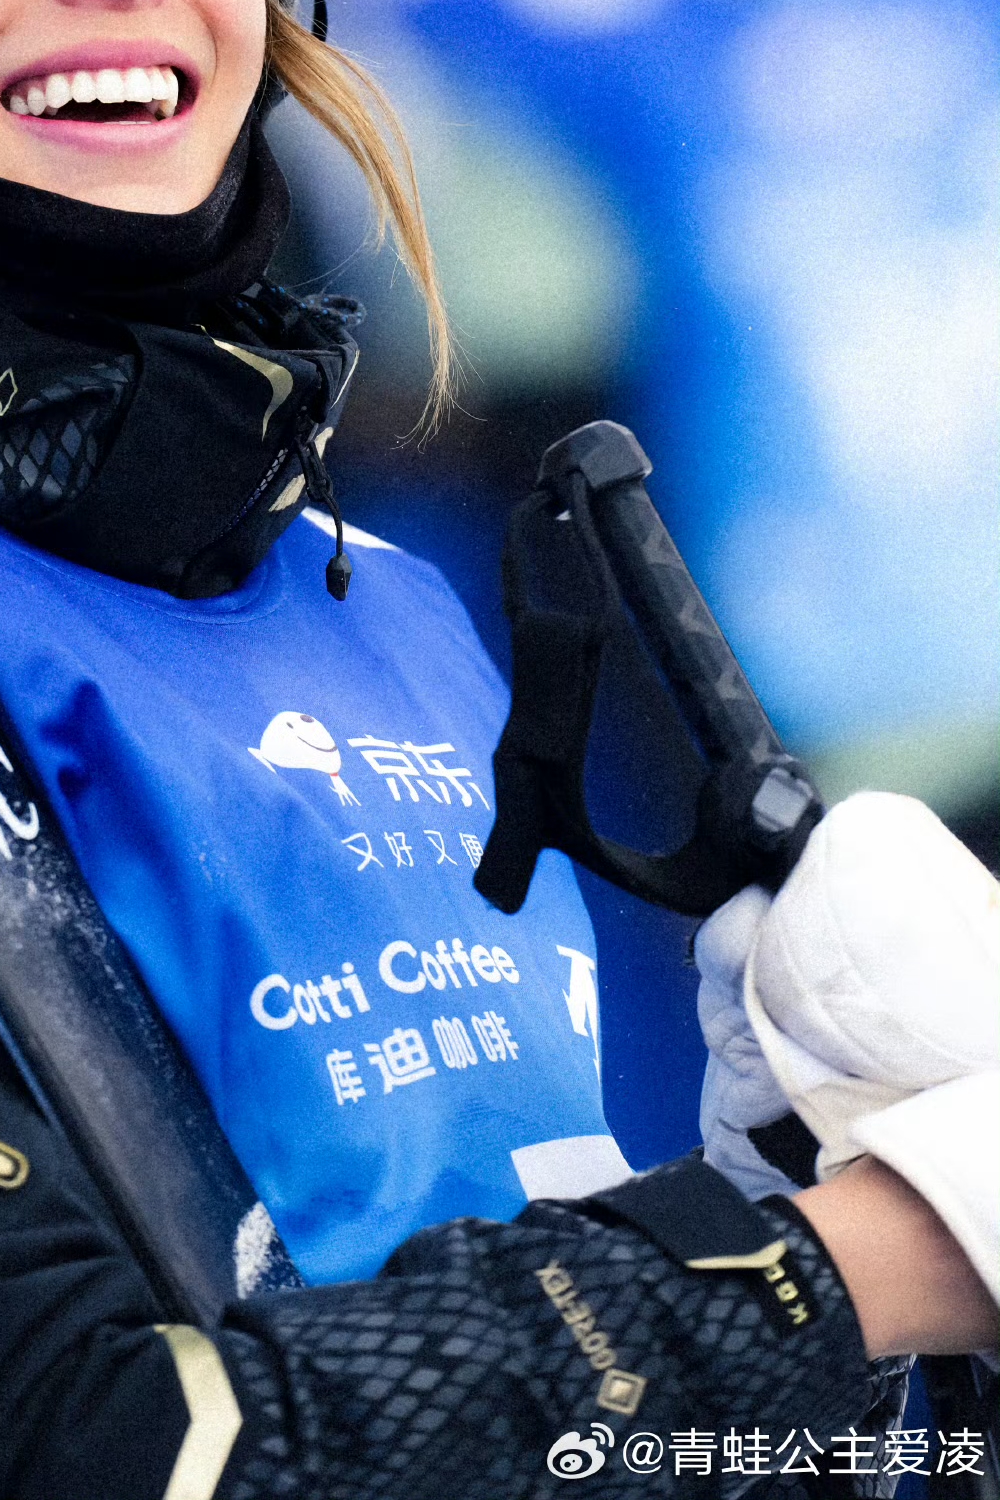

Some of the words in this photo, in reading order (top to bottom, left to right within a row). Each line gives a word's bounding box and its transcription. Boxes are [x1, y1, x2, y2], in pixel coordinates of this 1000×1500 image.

[346, 734, 492, 811] 京东
[250, 962, 371, 1031] Cotti
[378, 937, 521, 995] Coffee
[325, 1010, 520, 1106] 库迪咖啡
